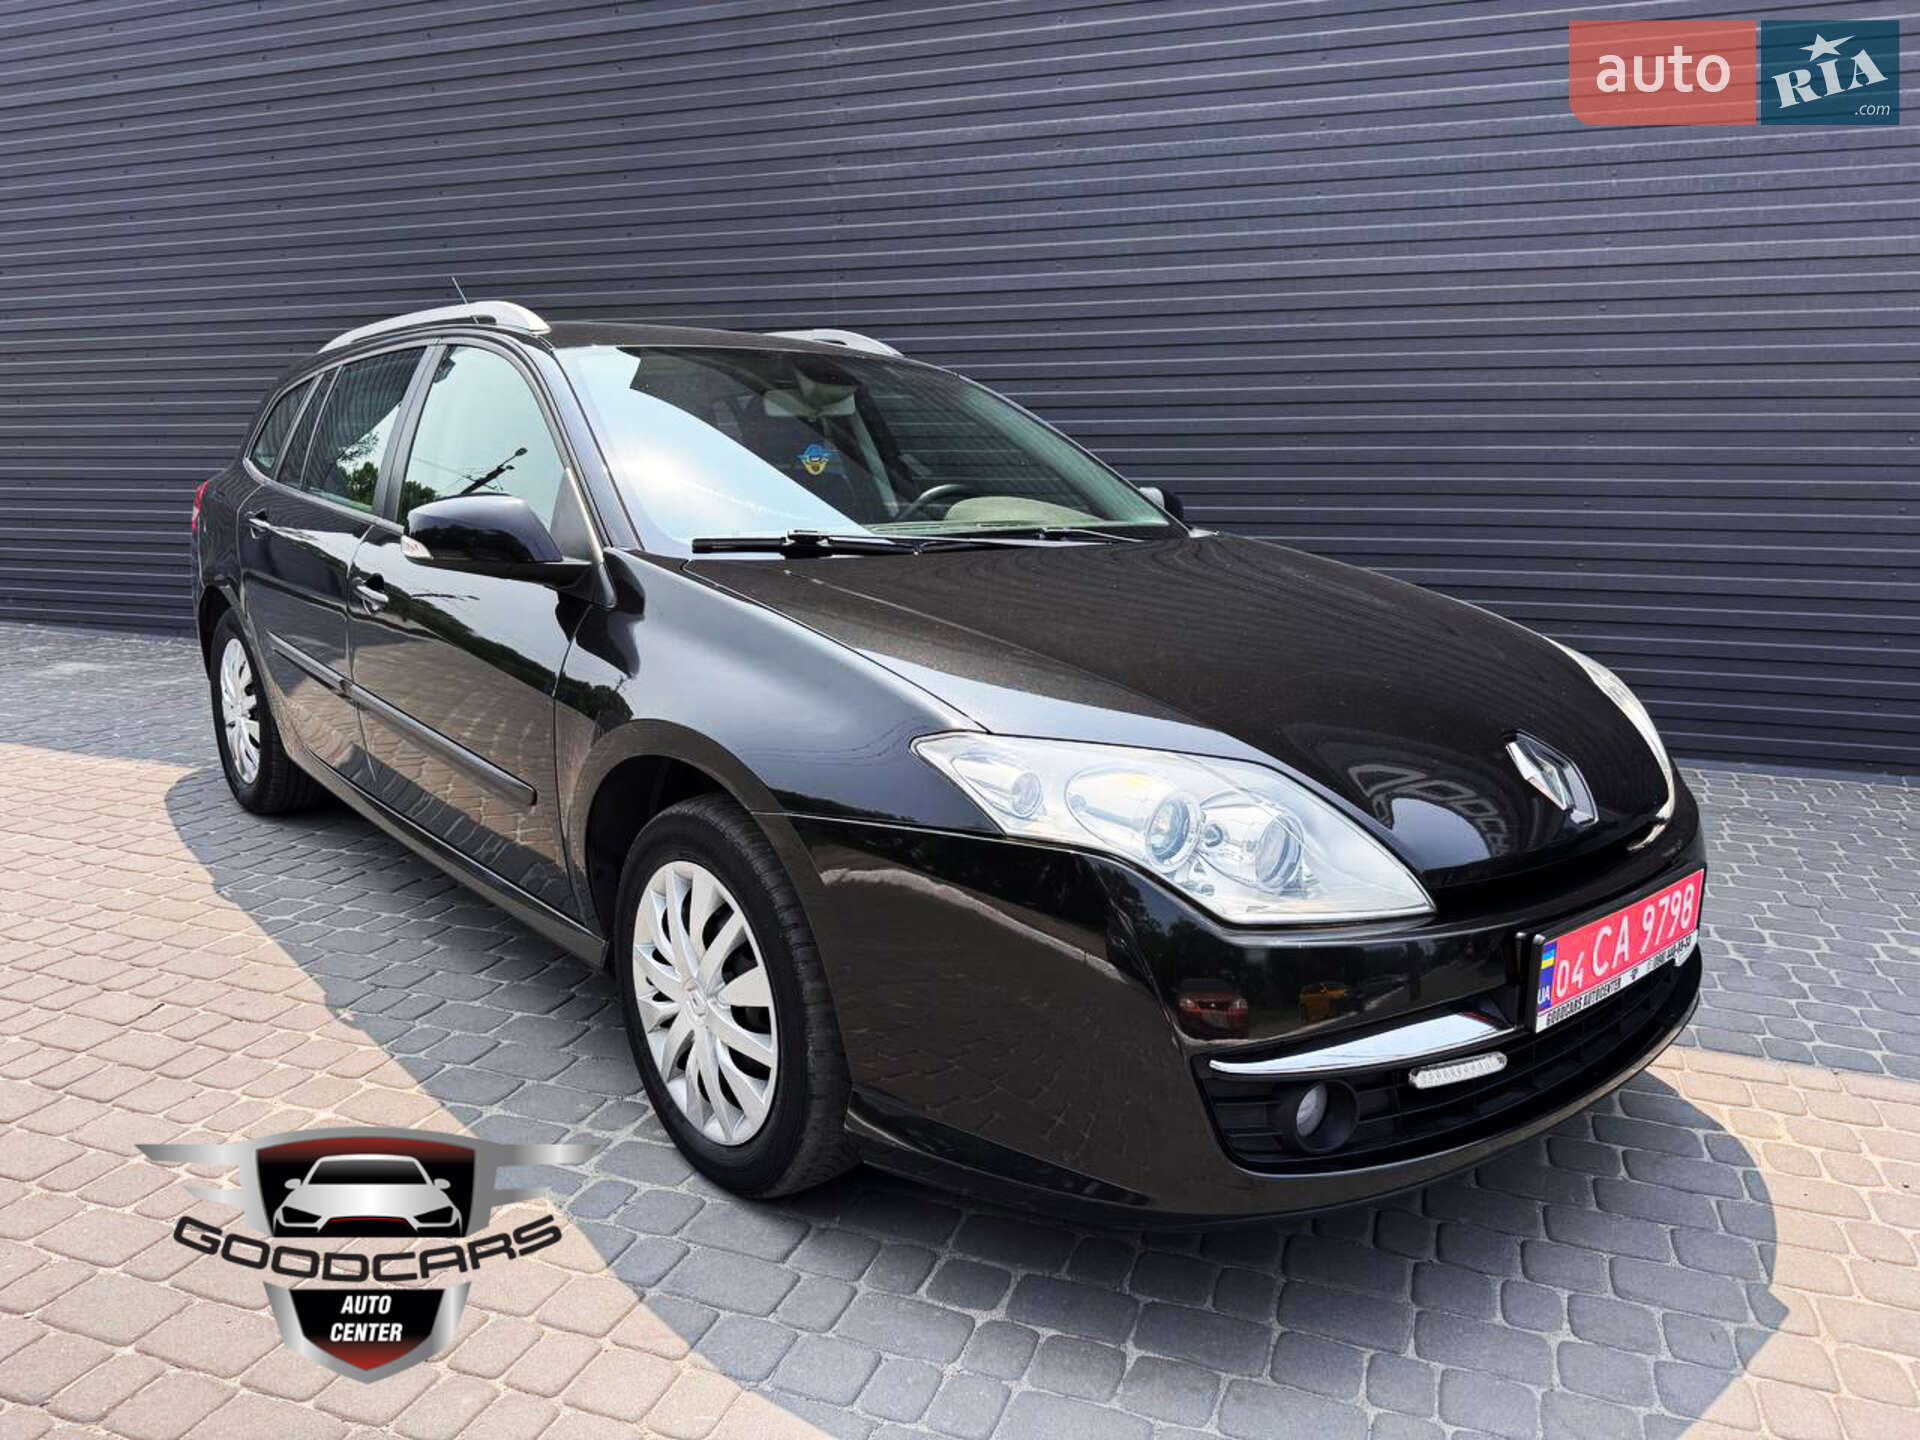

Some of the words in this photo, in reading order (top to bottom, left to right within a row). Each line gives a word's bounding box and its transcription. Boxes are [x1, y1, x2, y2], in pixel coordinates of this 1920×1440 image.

[1556, 951, 1584, 998] 04
[1592, 915, 1630, 977] CA
[1640, 883, 1695, 955] 9798
[1537, 985, 1551, 1005] UA
